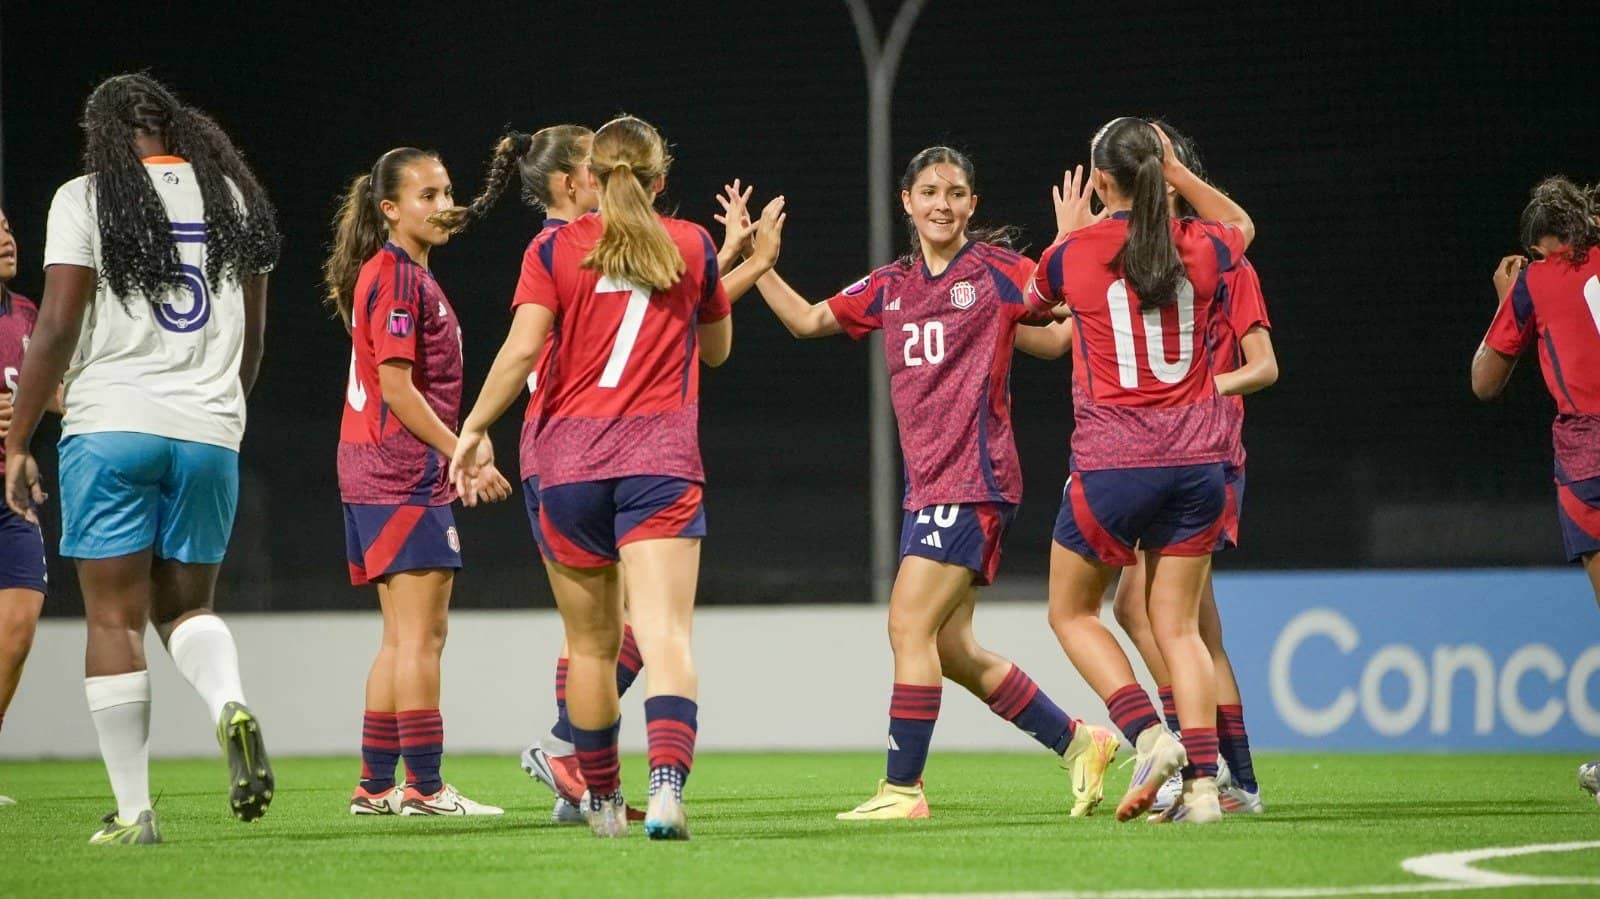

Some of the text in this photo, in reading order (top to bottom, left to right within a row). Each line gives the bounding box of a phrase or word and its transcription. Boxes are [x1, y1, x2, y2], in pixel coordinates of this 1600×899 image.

[595, 276, 652, 388] 7
[956, 287, 970, 304] CR
[1106, 277, 1195, 388] 10
[902, 320, 945, 366] 20
